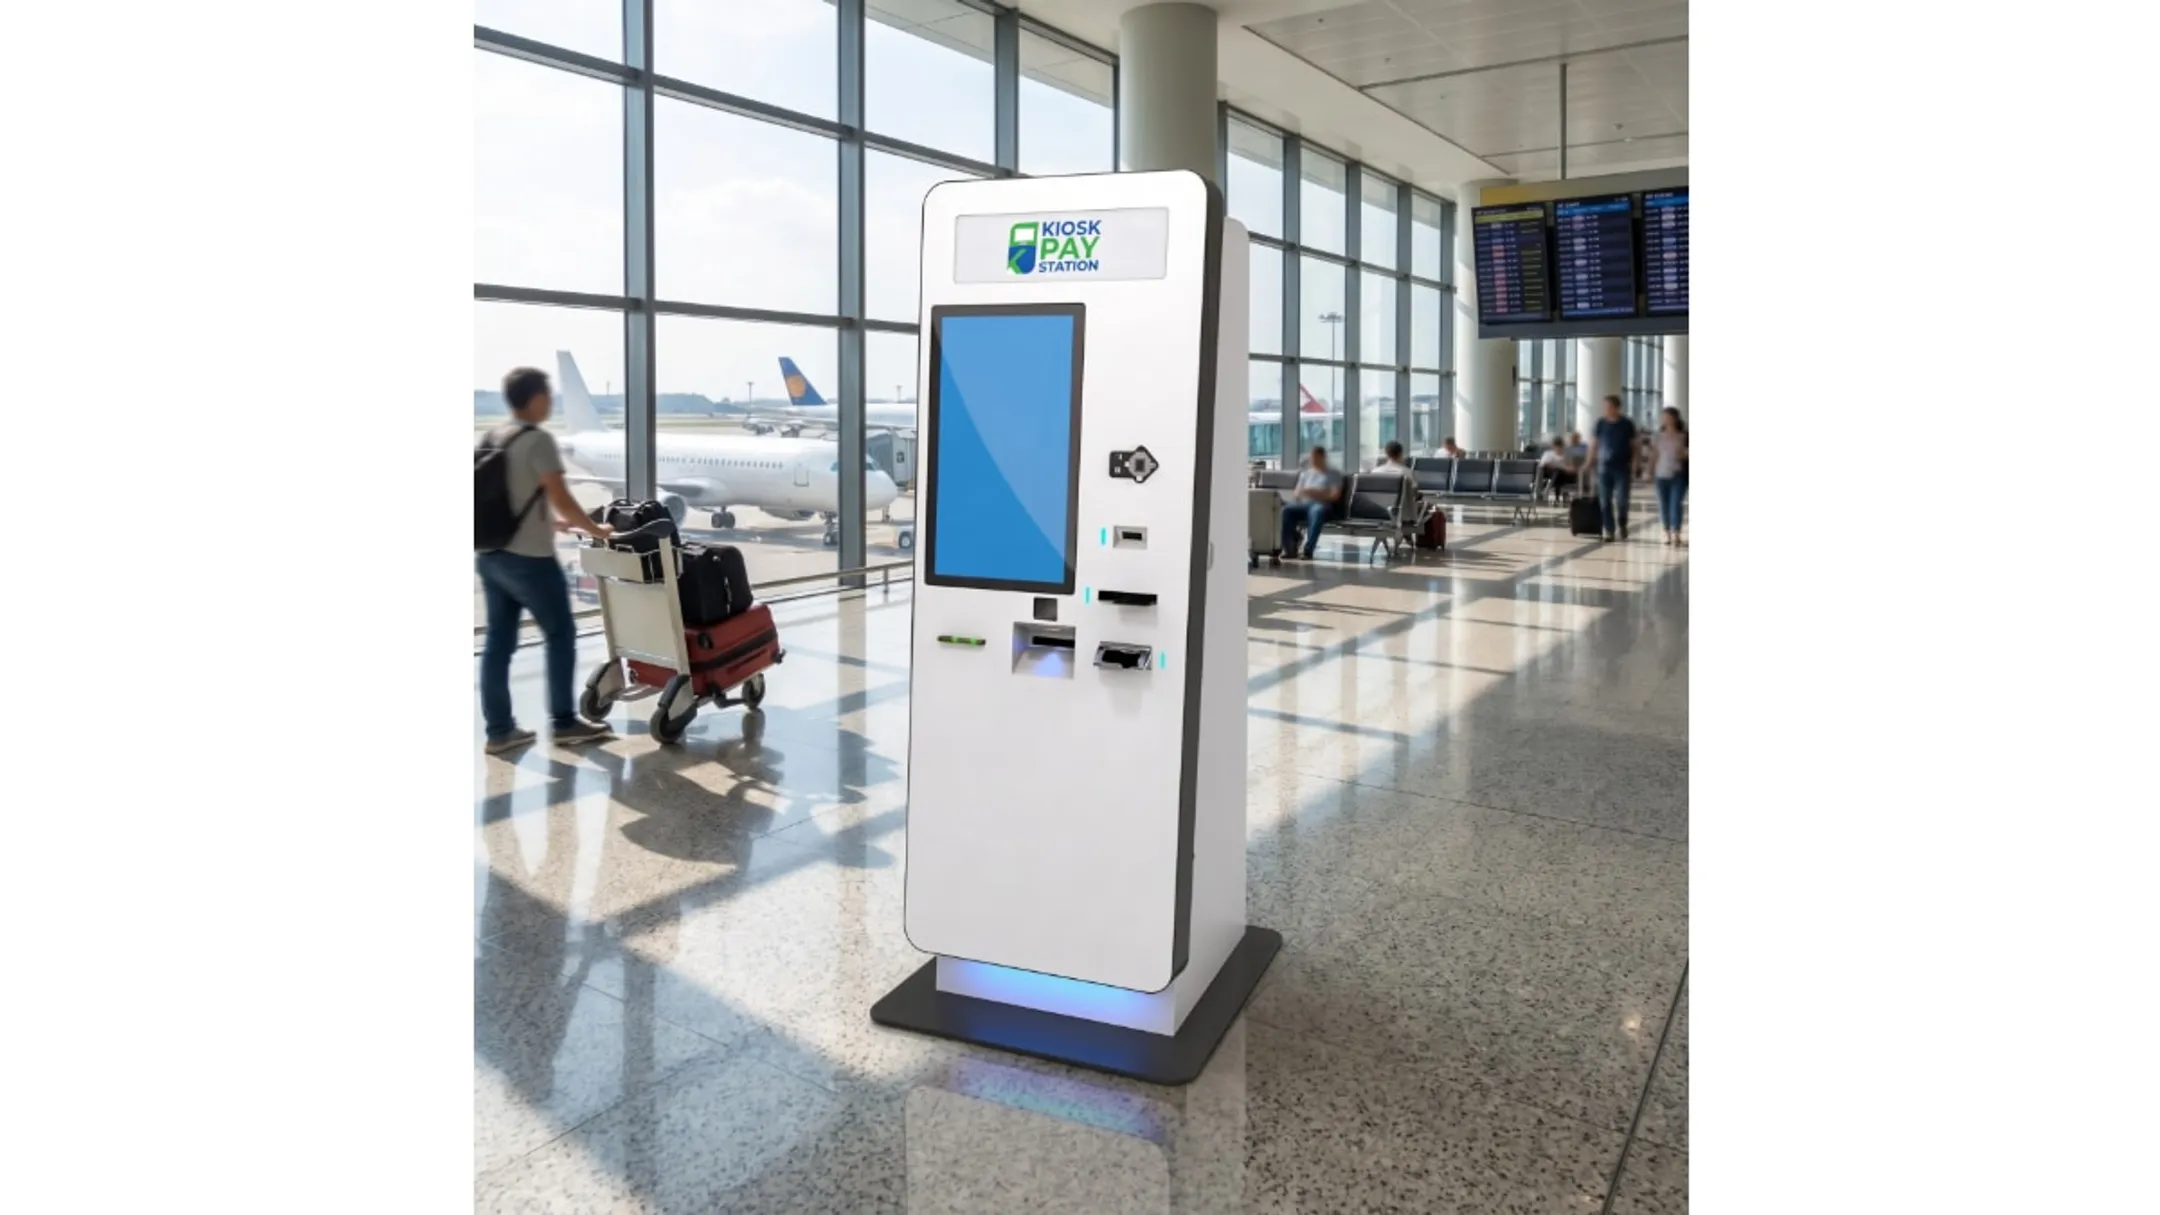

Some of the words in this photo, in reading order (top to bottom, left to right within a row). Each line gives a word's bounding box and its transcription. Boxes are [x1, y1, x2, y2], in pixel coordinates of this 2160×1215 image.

[1042, 220, 1101, 236] KIOSK
[1040, 236, 1100, 260] PAY
[1039, 260, 1099, 273] STATION
